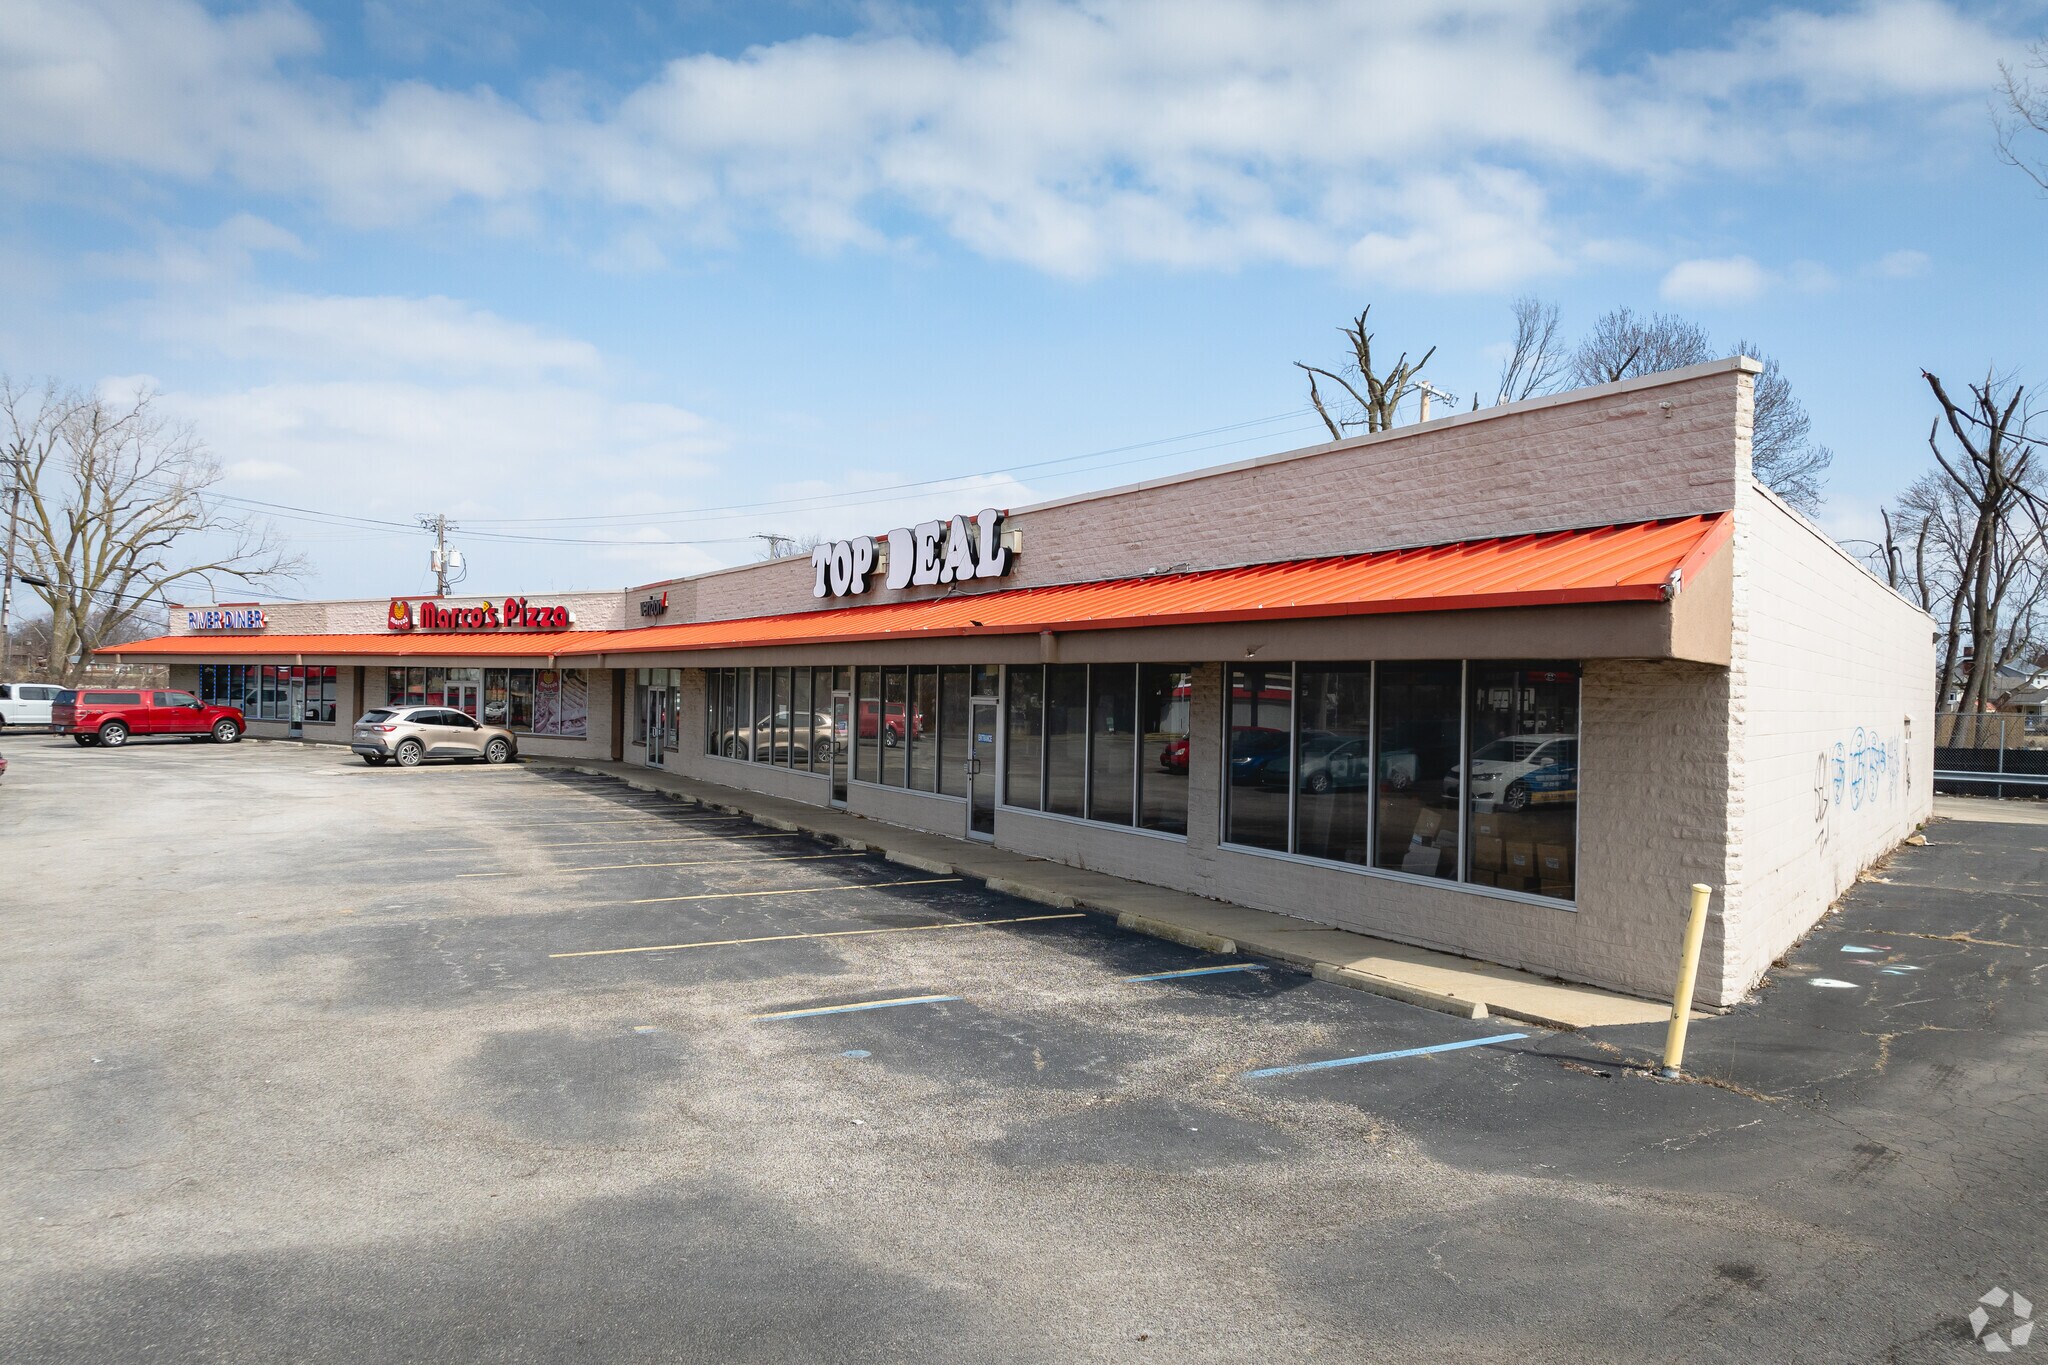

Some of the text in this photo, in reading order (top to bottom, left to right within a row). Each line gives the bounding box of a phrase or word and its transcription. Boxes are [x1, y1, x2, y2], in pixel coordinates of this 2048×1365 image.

[812, 508, 1011, 598] TOP DEAL
[188, 610, 265, 629] RIVER DINER
[420, 597, 569, 628] Marco's Pizza
